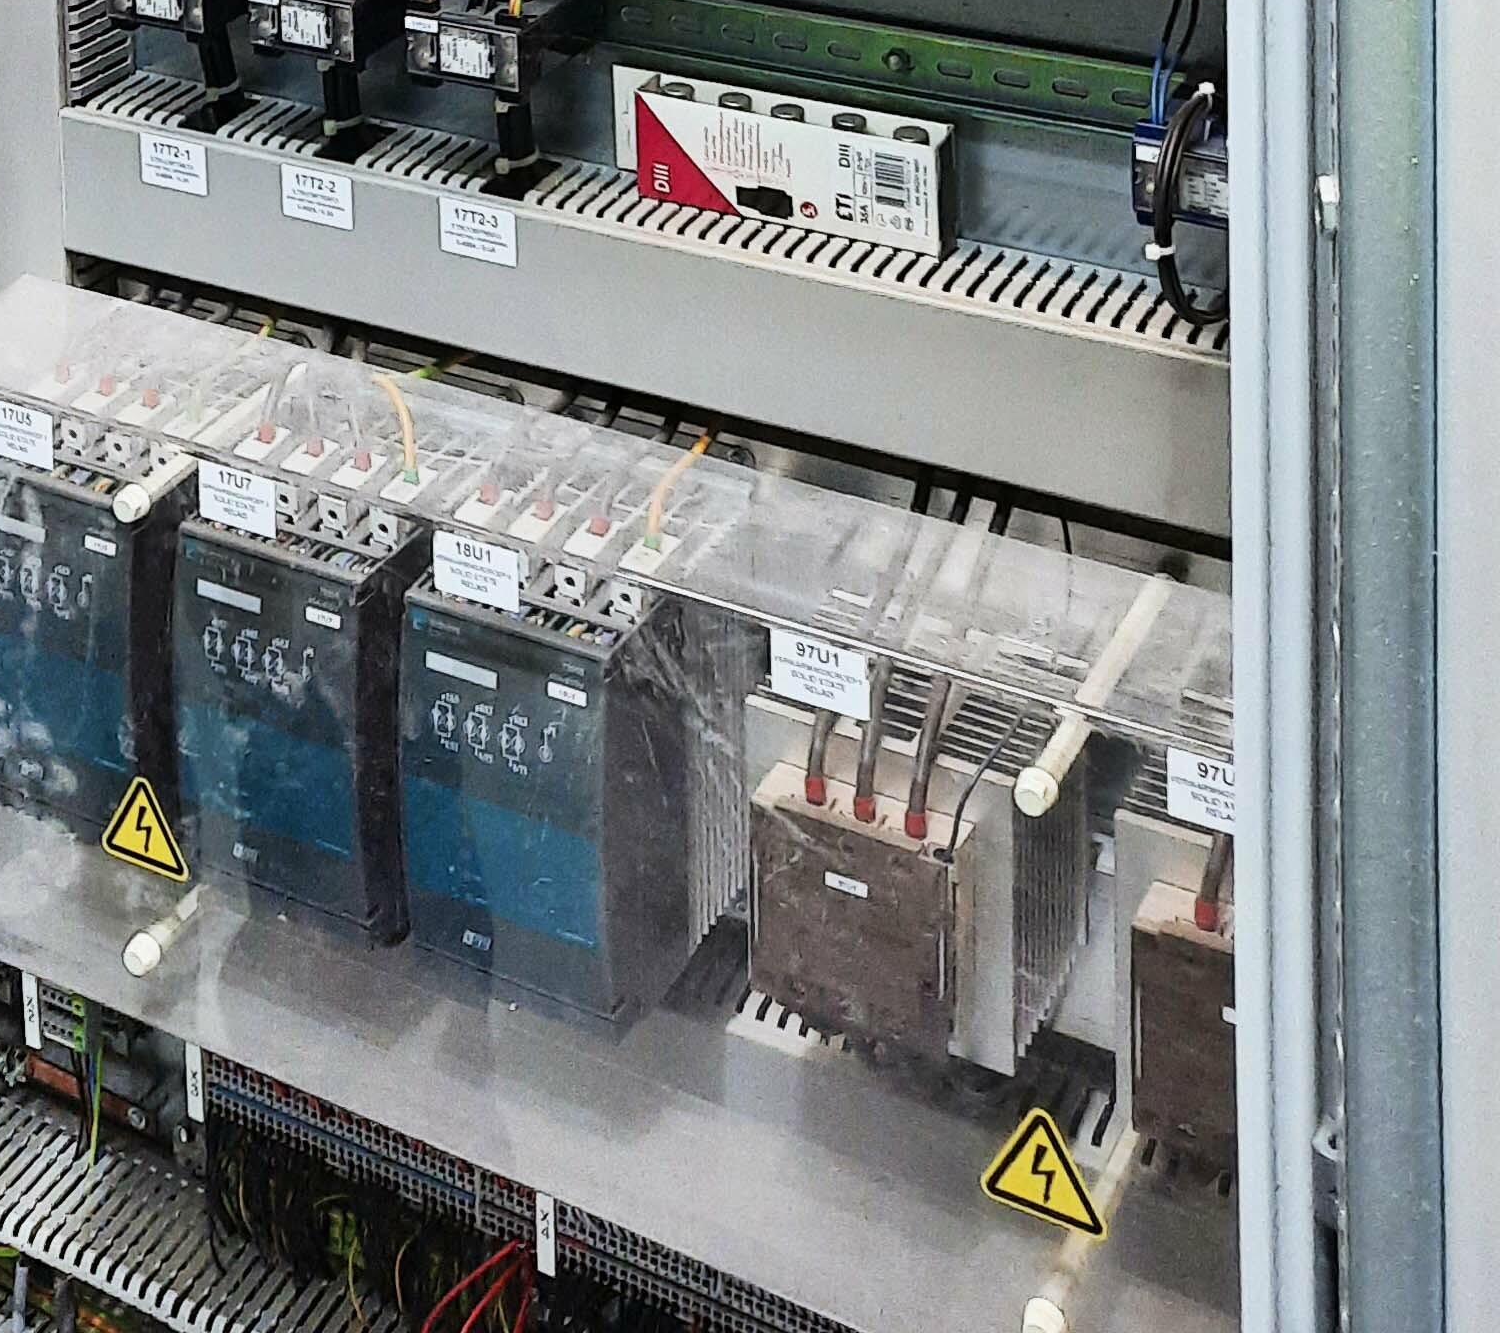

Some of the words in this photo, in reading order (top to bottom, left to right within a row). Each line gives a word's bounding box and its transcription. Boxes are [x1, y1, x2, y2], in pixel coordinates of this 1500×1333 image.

[152, 142, 191, 161] 17T2-1
[294, 172, 337, 194] 17T2-2
[653, 162, 671, 194] DIII
[453, 207, 499, 229] 17T2-3
[835, 193, 854, 222] ETI
[2, 407, 32, 426] 17U5
[219, 470, 252, 490] 17U7
[456, 541, 491, 564] 18U1
[796, 641, 839, 667] 97U1
[540, 1209, 549, 1240] X4
